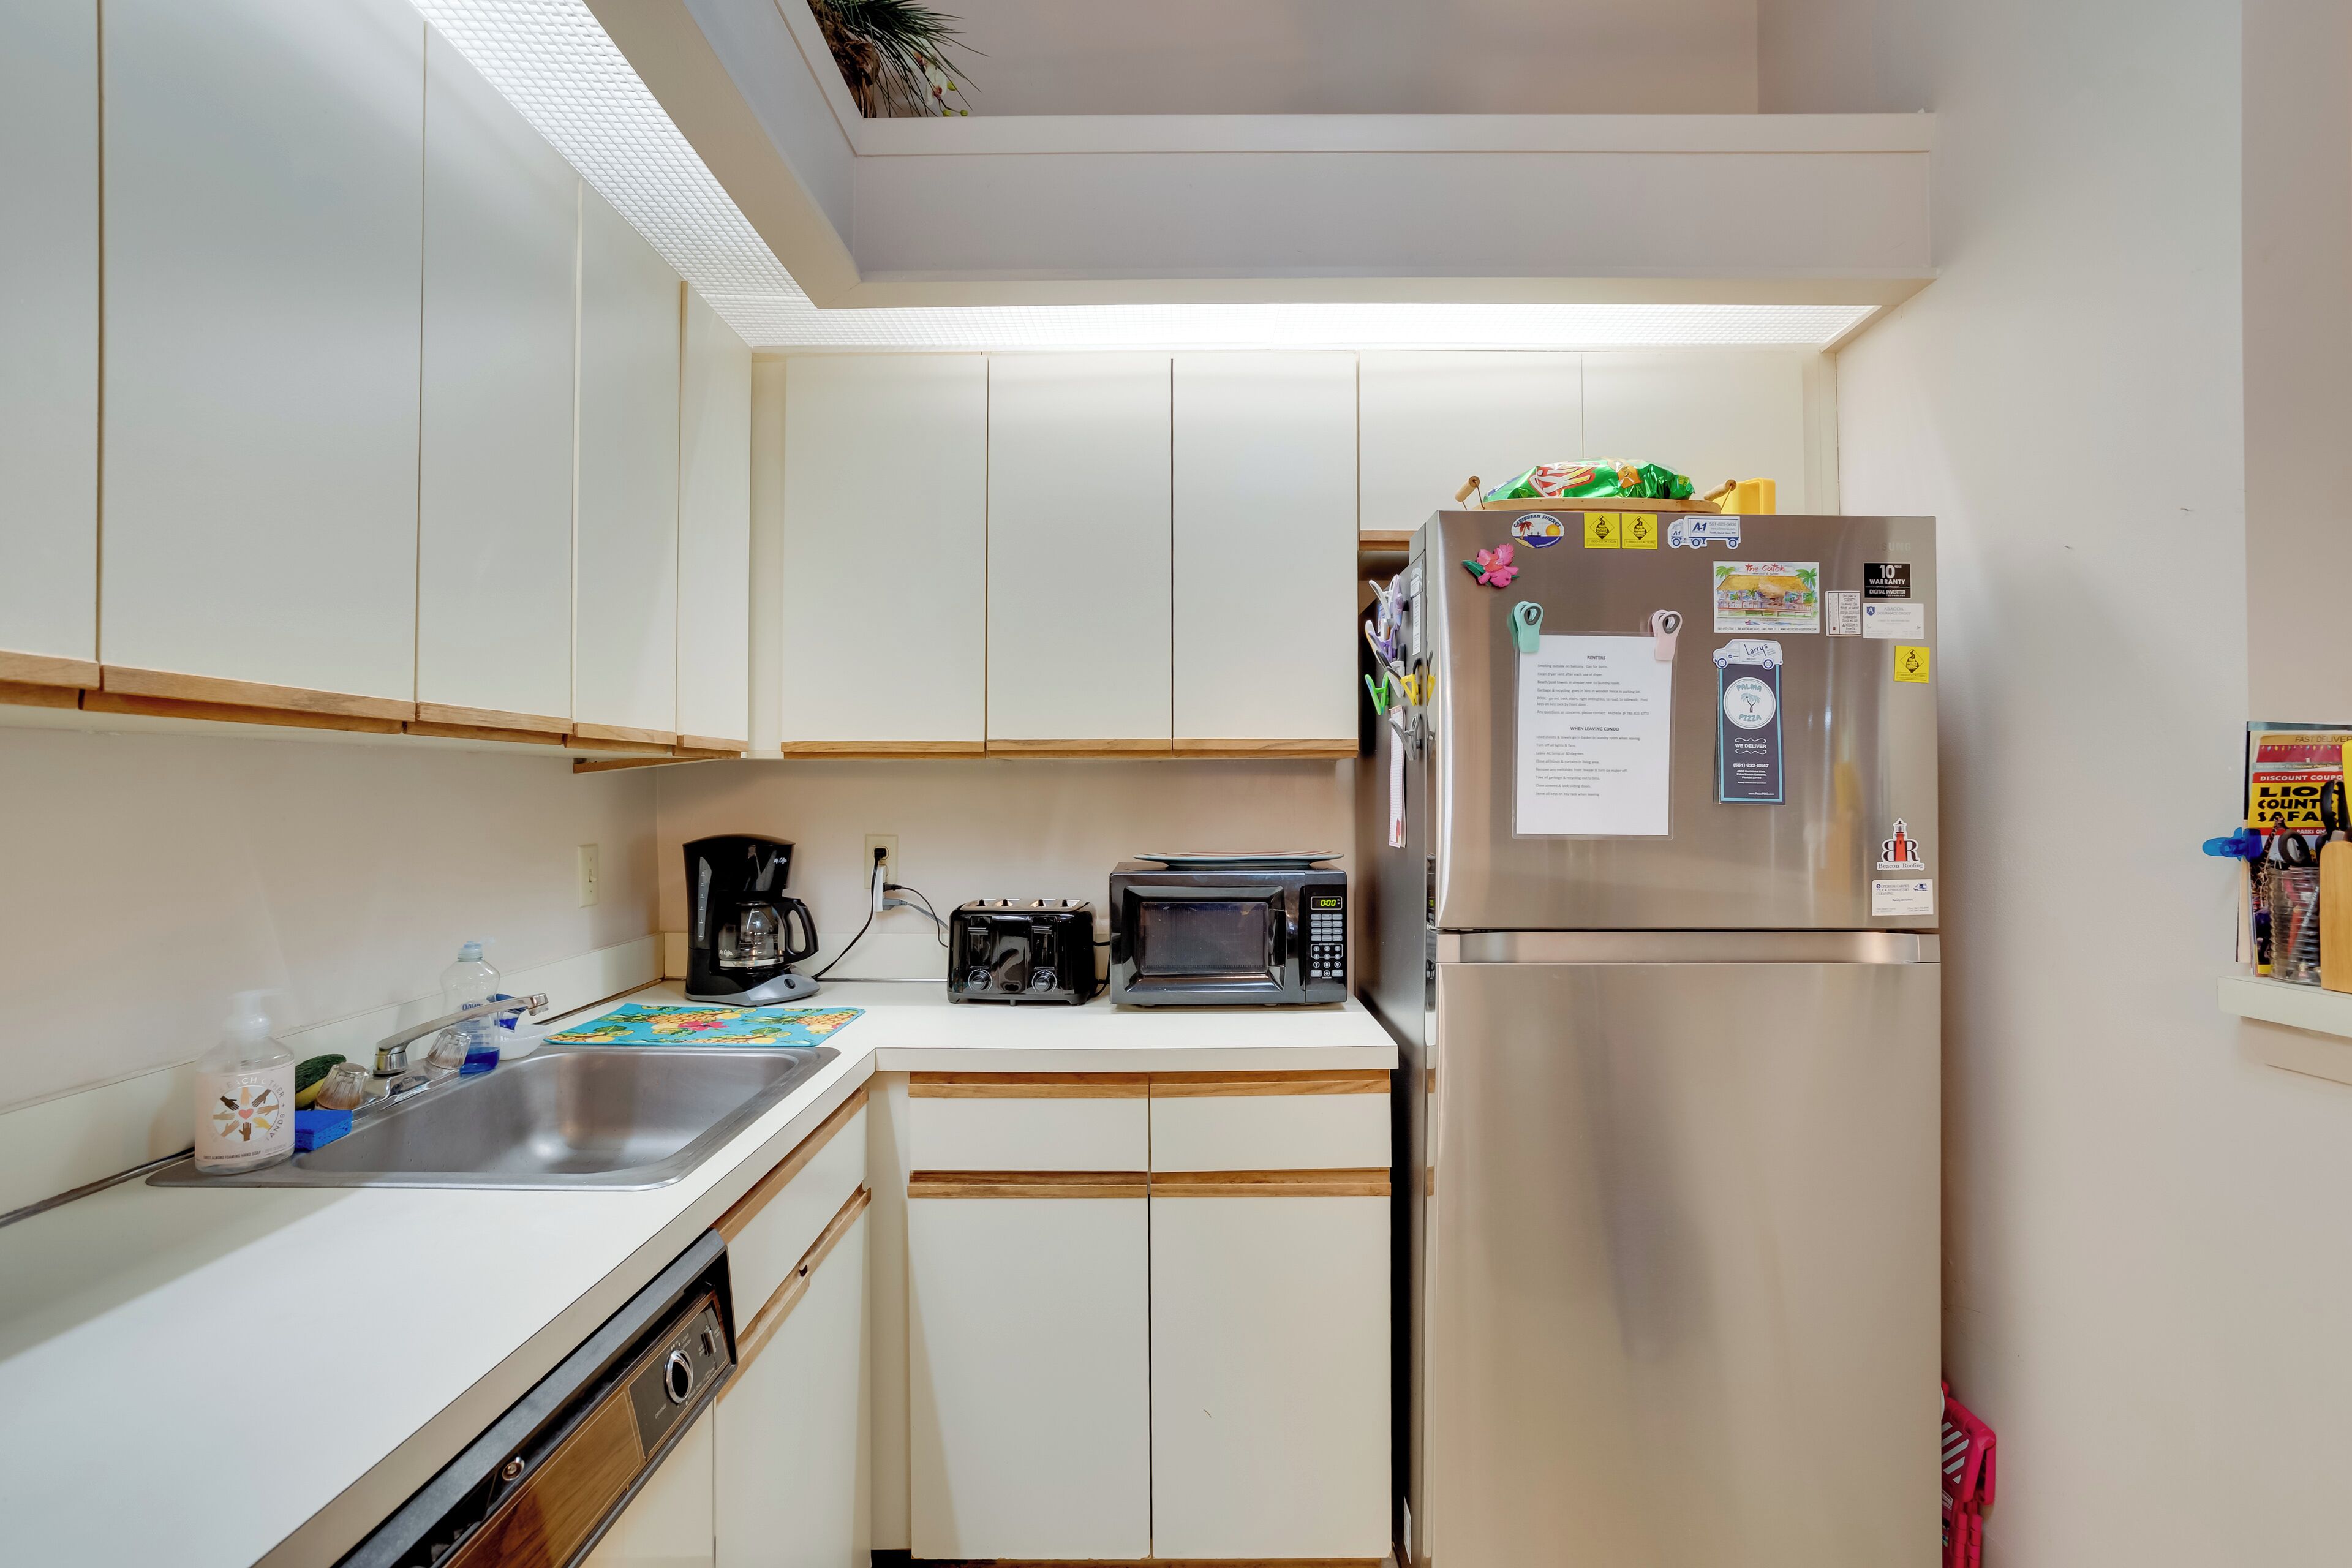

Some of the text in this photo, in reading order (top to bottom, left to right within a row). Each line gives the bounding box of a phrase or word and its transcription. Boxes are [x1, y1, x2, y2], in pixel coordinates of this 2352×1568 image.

[1513, 514, 1562, 528] CARIBBEAN SHORES
[1762, 563, 1785, 573] Catch
[1880, 565, 1896, 579] 10
[1736, 684, 1762, 692] PALMA
[2258, 799, 2334, 809] COUNT
[2258, 811, 2336, 822] SAFA
[266, 1113, 285, 1141] ANDS
